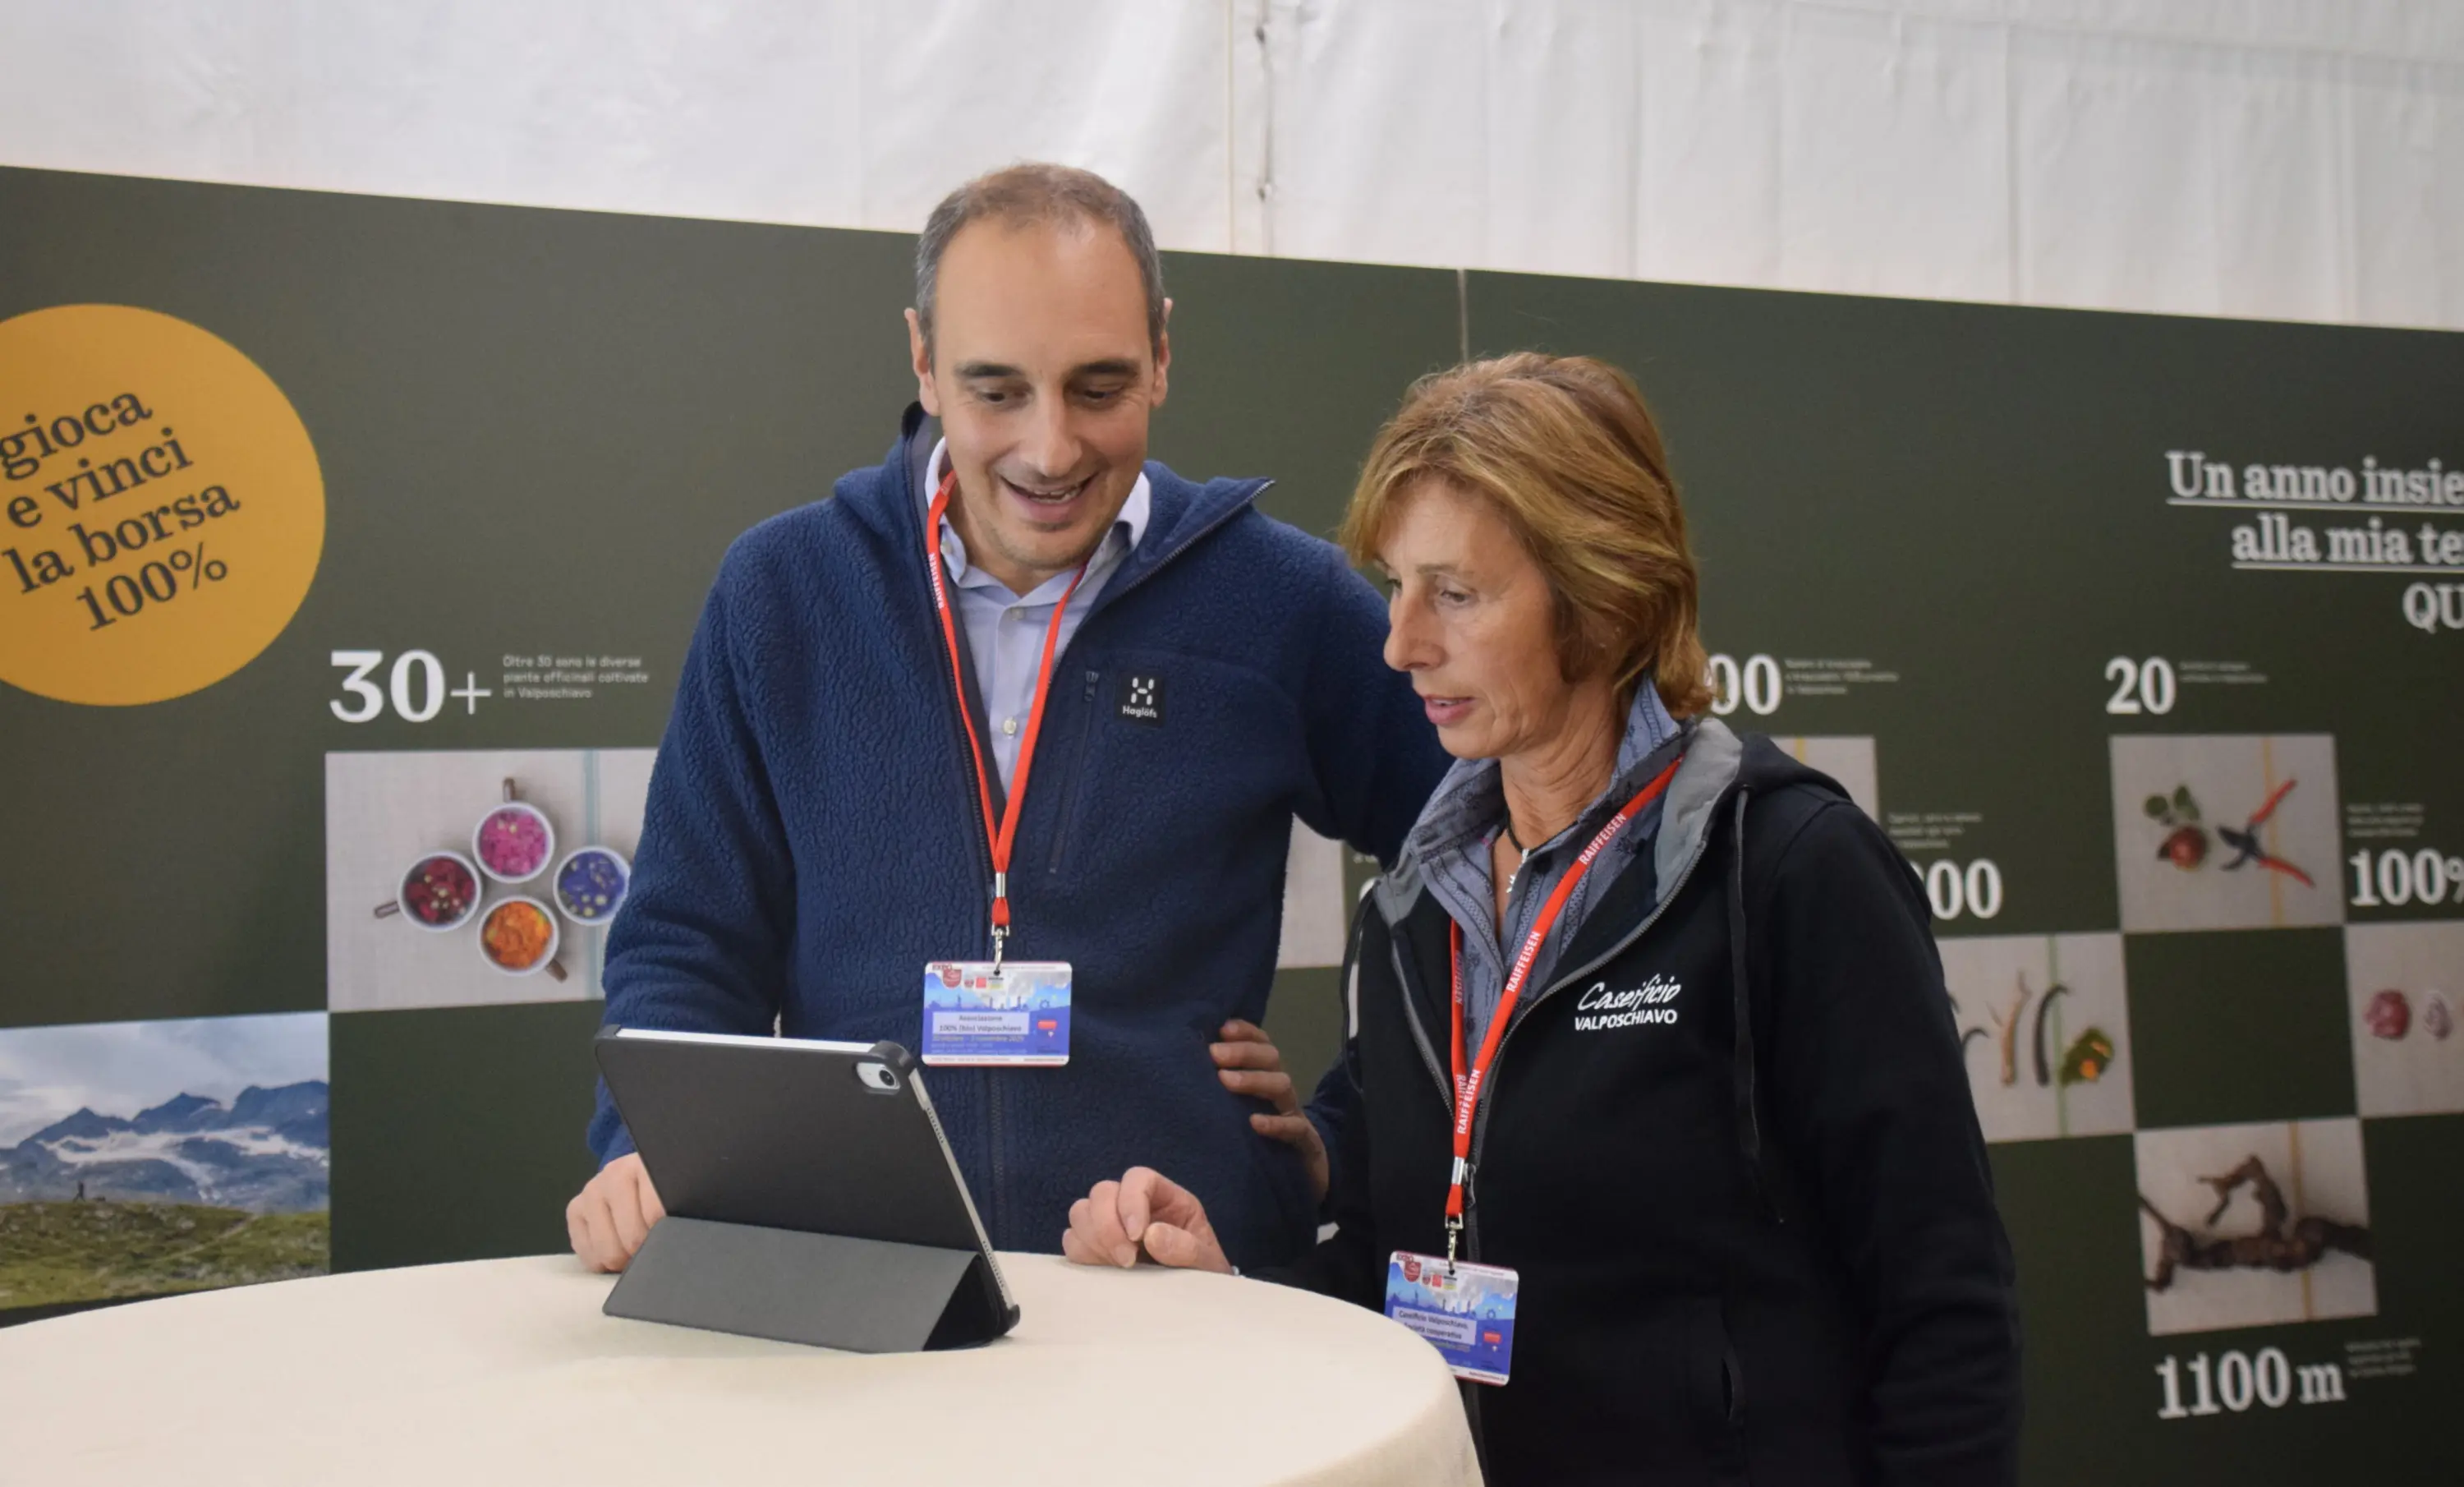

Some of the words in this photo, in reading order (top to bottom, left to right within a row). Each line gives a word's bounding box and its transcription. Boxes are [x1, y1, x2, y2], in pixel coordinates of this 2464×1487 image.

[0, 393, 154, 481] gioca
[7, 494, 43, 528] e
[44, 427, 195, 511] vinci
[2164, 450, 2237, 498] Un
[2243, 463, 2357, 503] anno
[2361, 454, 2464, 505] insie
[2, 546, 75, 595] la
[67, 483, 241, 569] borsa
[2231, 512, 2322, 562] alla
[2325, 515, 2415, 564] mia
[76, 541, 228, 632] 100%
[503, 656, 534, 668] Oltre
[537, 656, 553, 668] 30
[600, 656, 642, 668] diverse
[543, 670, 595, 684] officinali
[598, 671, 650, 684] coltivate
[2104, 656, 2177, 716] 20
[503, 688, 515, 698] in
[517, 687, 594, 700] Valposchiavo
[1579, 813, 1627, 866] RAIFFEISEN
[1910, 859, 2002, 921] 00
[1506, 931, 1541, 992] RAIFFEISEN
[1574, 1009, 1678, 1031] VALPOSCHIAVO
[1577, 974, 1681, 1011] Caseificio
[1457, 1070, 1481, 1134] RAIFFEISEN
[2155, 1347, 2292, 1420] 1100
[2296, 1363, 2347, 1404] m
